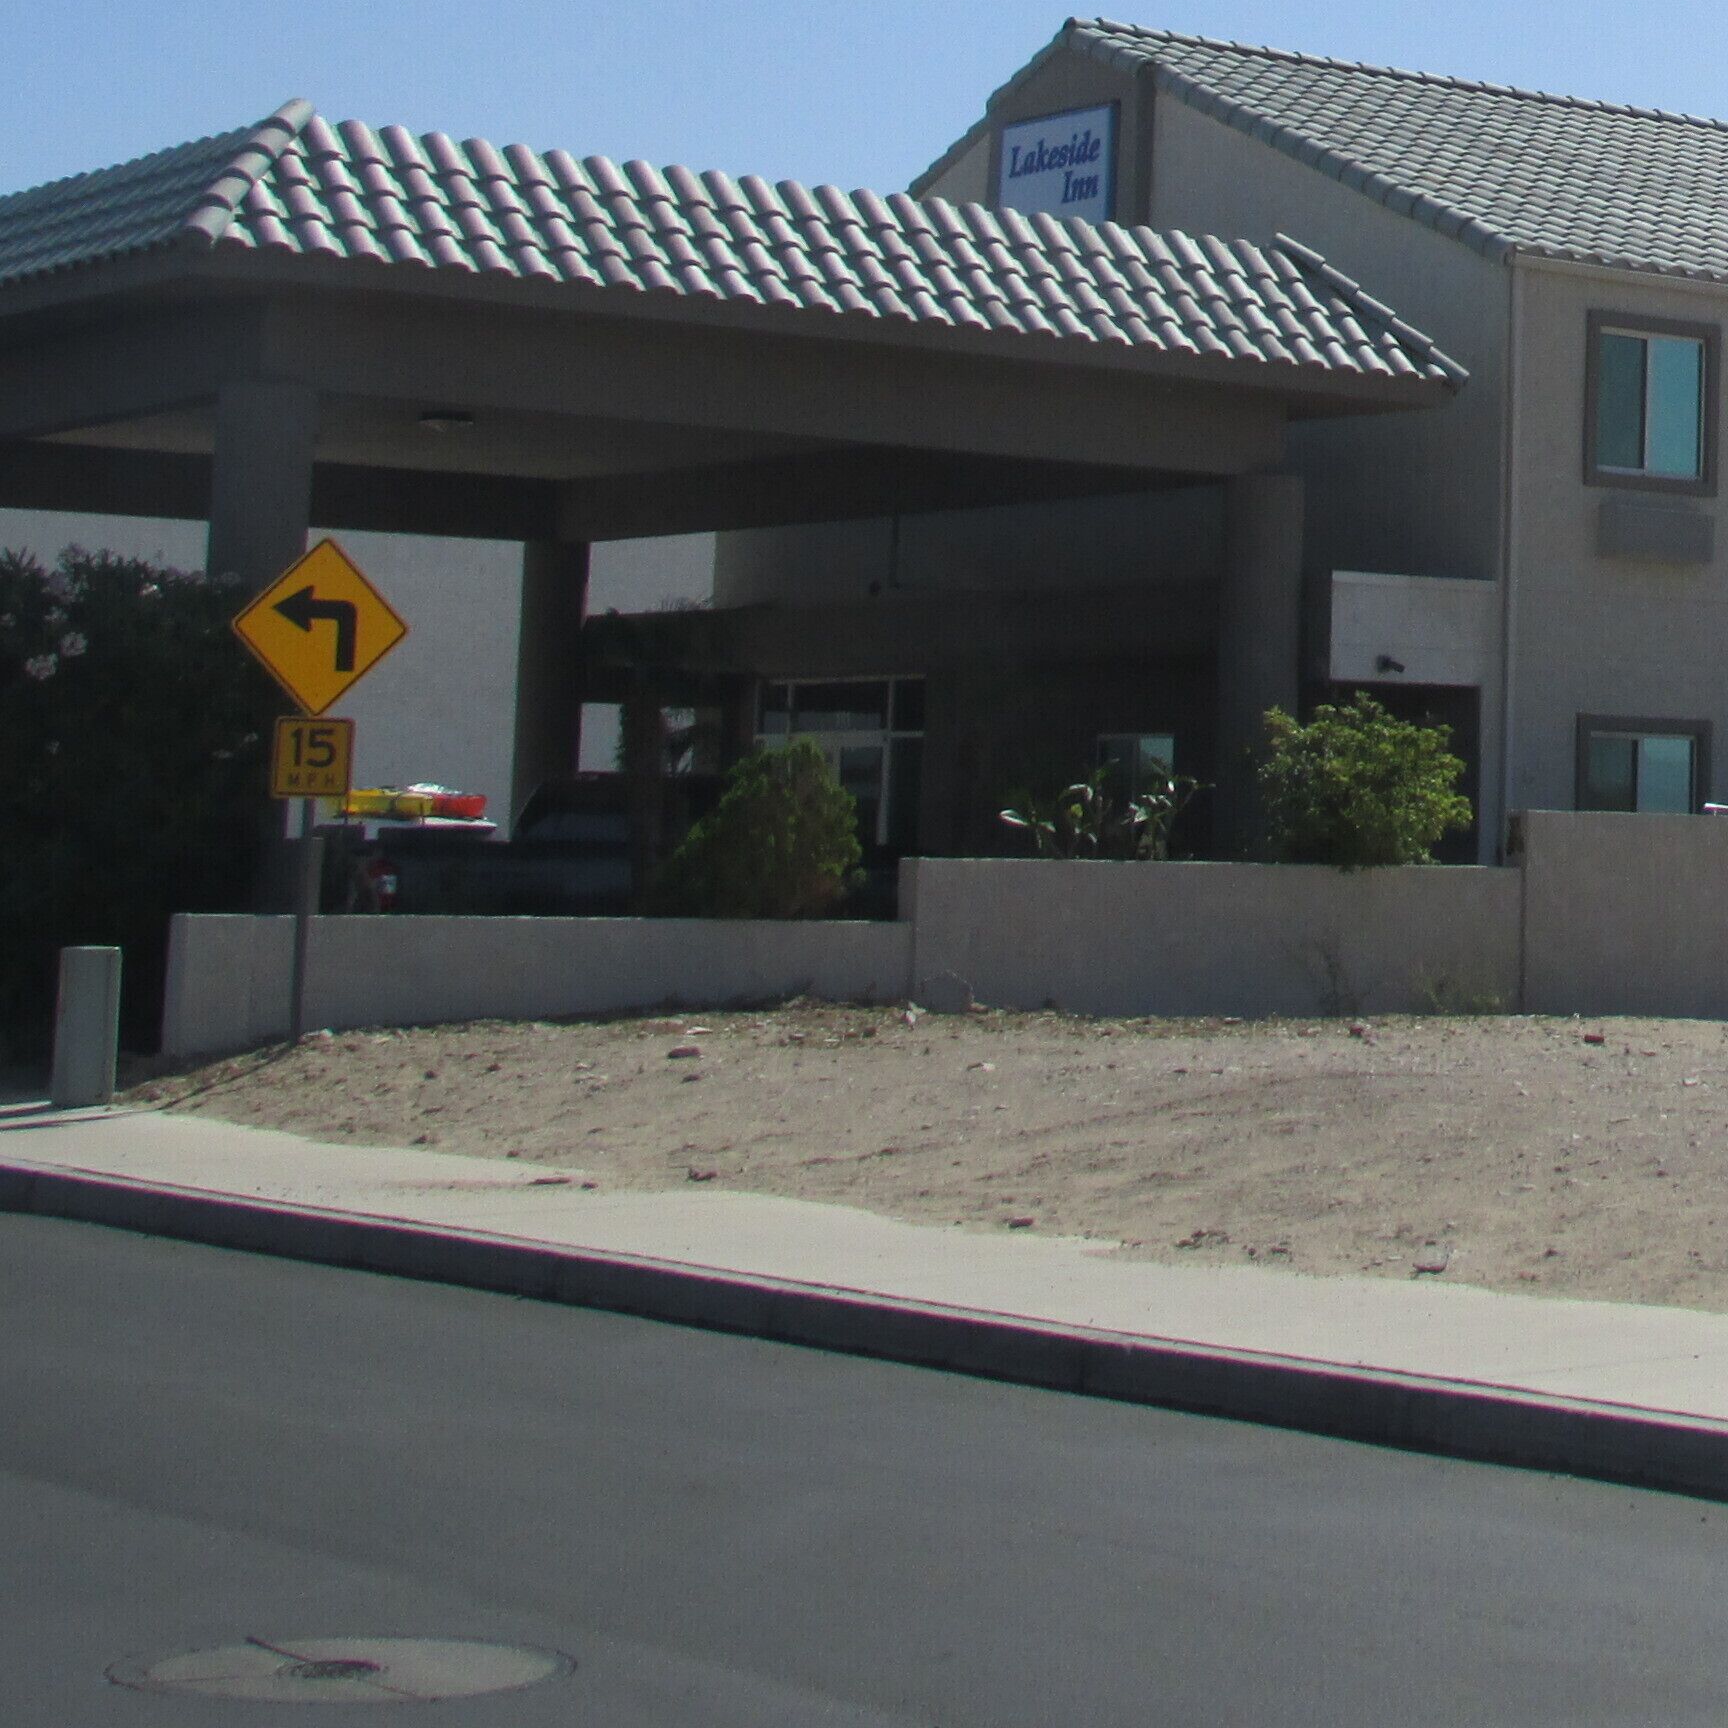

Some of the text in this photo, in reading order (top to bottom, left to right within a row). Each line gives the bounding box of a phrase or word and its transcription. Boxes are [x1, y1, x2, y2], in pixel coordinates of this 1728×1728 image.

[1009, 130, 1100, 178] Lakeside
[1061, 170, 1099, 203] Inn
[292, 728, 336, 768] 15
